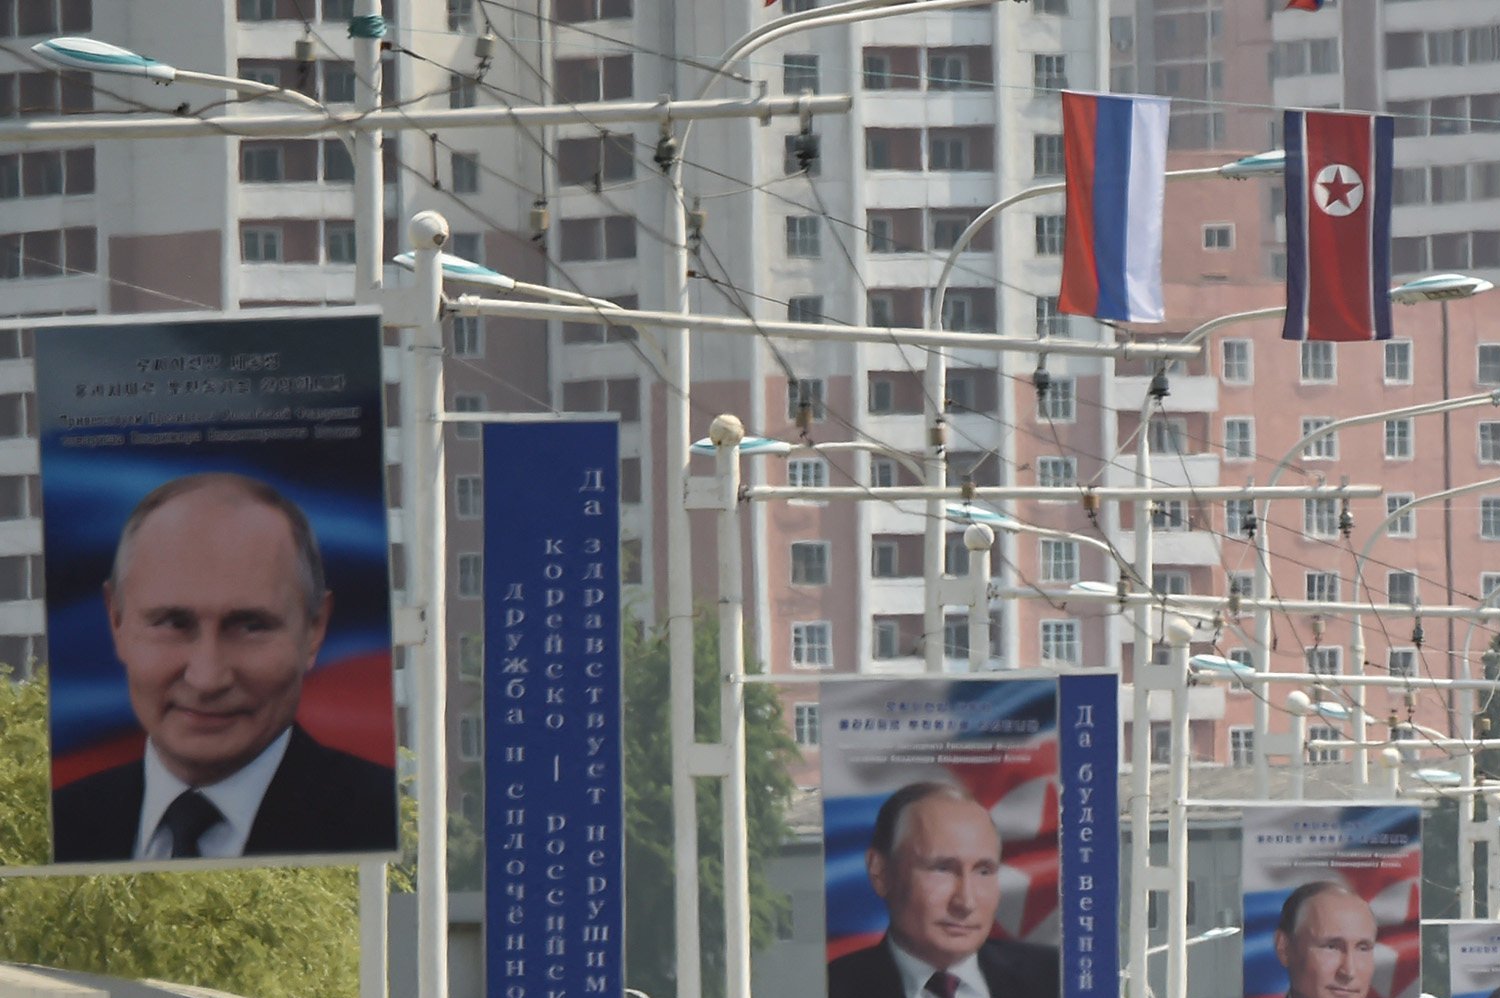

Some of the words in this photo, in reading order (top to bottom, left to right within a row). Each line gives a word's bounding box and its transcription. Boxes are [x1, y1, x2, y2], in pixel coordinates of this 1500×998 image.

[578, 467, 605, 516] Да
[502, 582, 530, 725] дружба
[582, 538, 606, 804] здравствует
[505, 746, 526, 763] и
[1074, 704, 1095, 748] Да
[1077, 763, 1094, 864] будет
[1078, 875, 1095, 990] вечной
